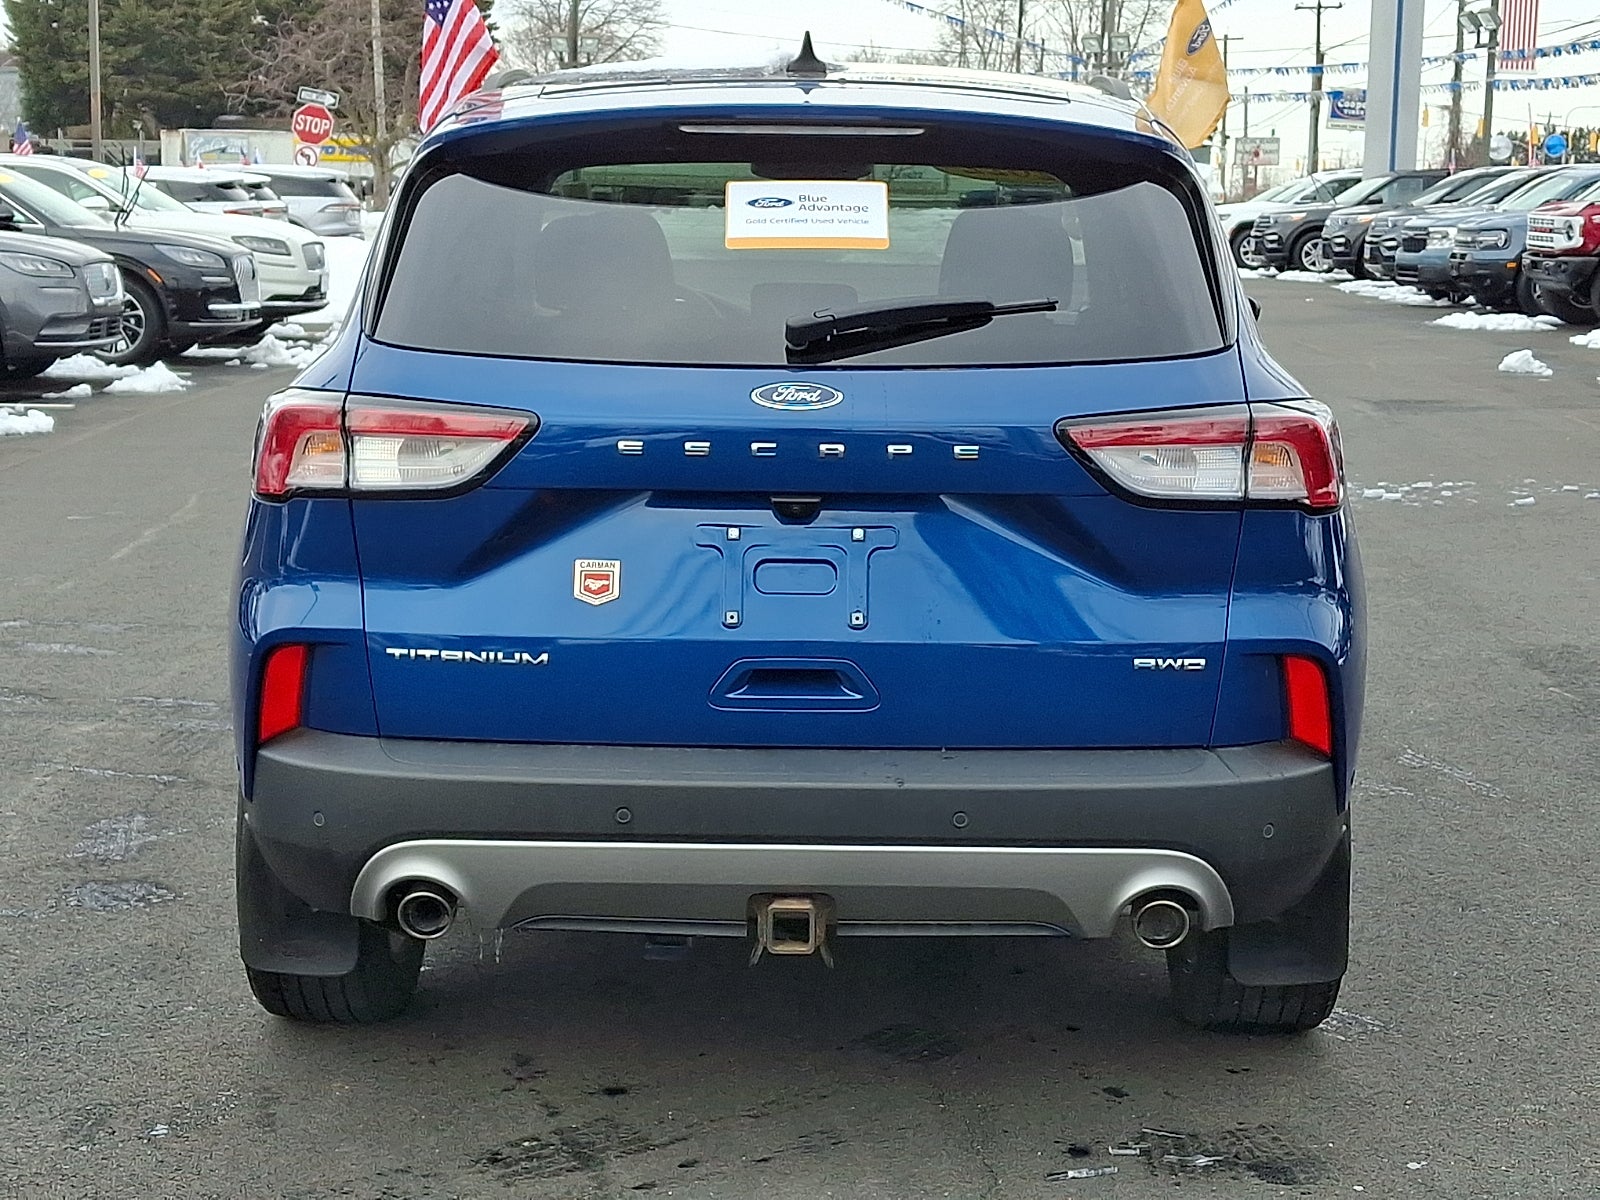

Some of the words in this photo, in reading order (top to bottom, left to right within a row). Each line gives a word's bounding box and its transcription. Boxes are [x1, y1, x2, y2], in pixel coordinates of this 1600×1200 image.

[295, 114, 330, 135] STOP
[798, 194, 828, 203] Blue
[798, 203, 869, 214] Advantage
[745, 217, 767, 225] Gold
[769, 217, 808, 225] Certified
[617, 440, 980, 460] ESCAPE
[579, 561, 616, 569] CARMAN
[385, 647, 549, 665] TITANIUM
[1133, 658, 1206, 670] AWD
